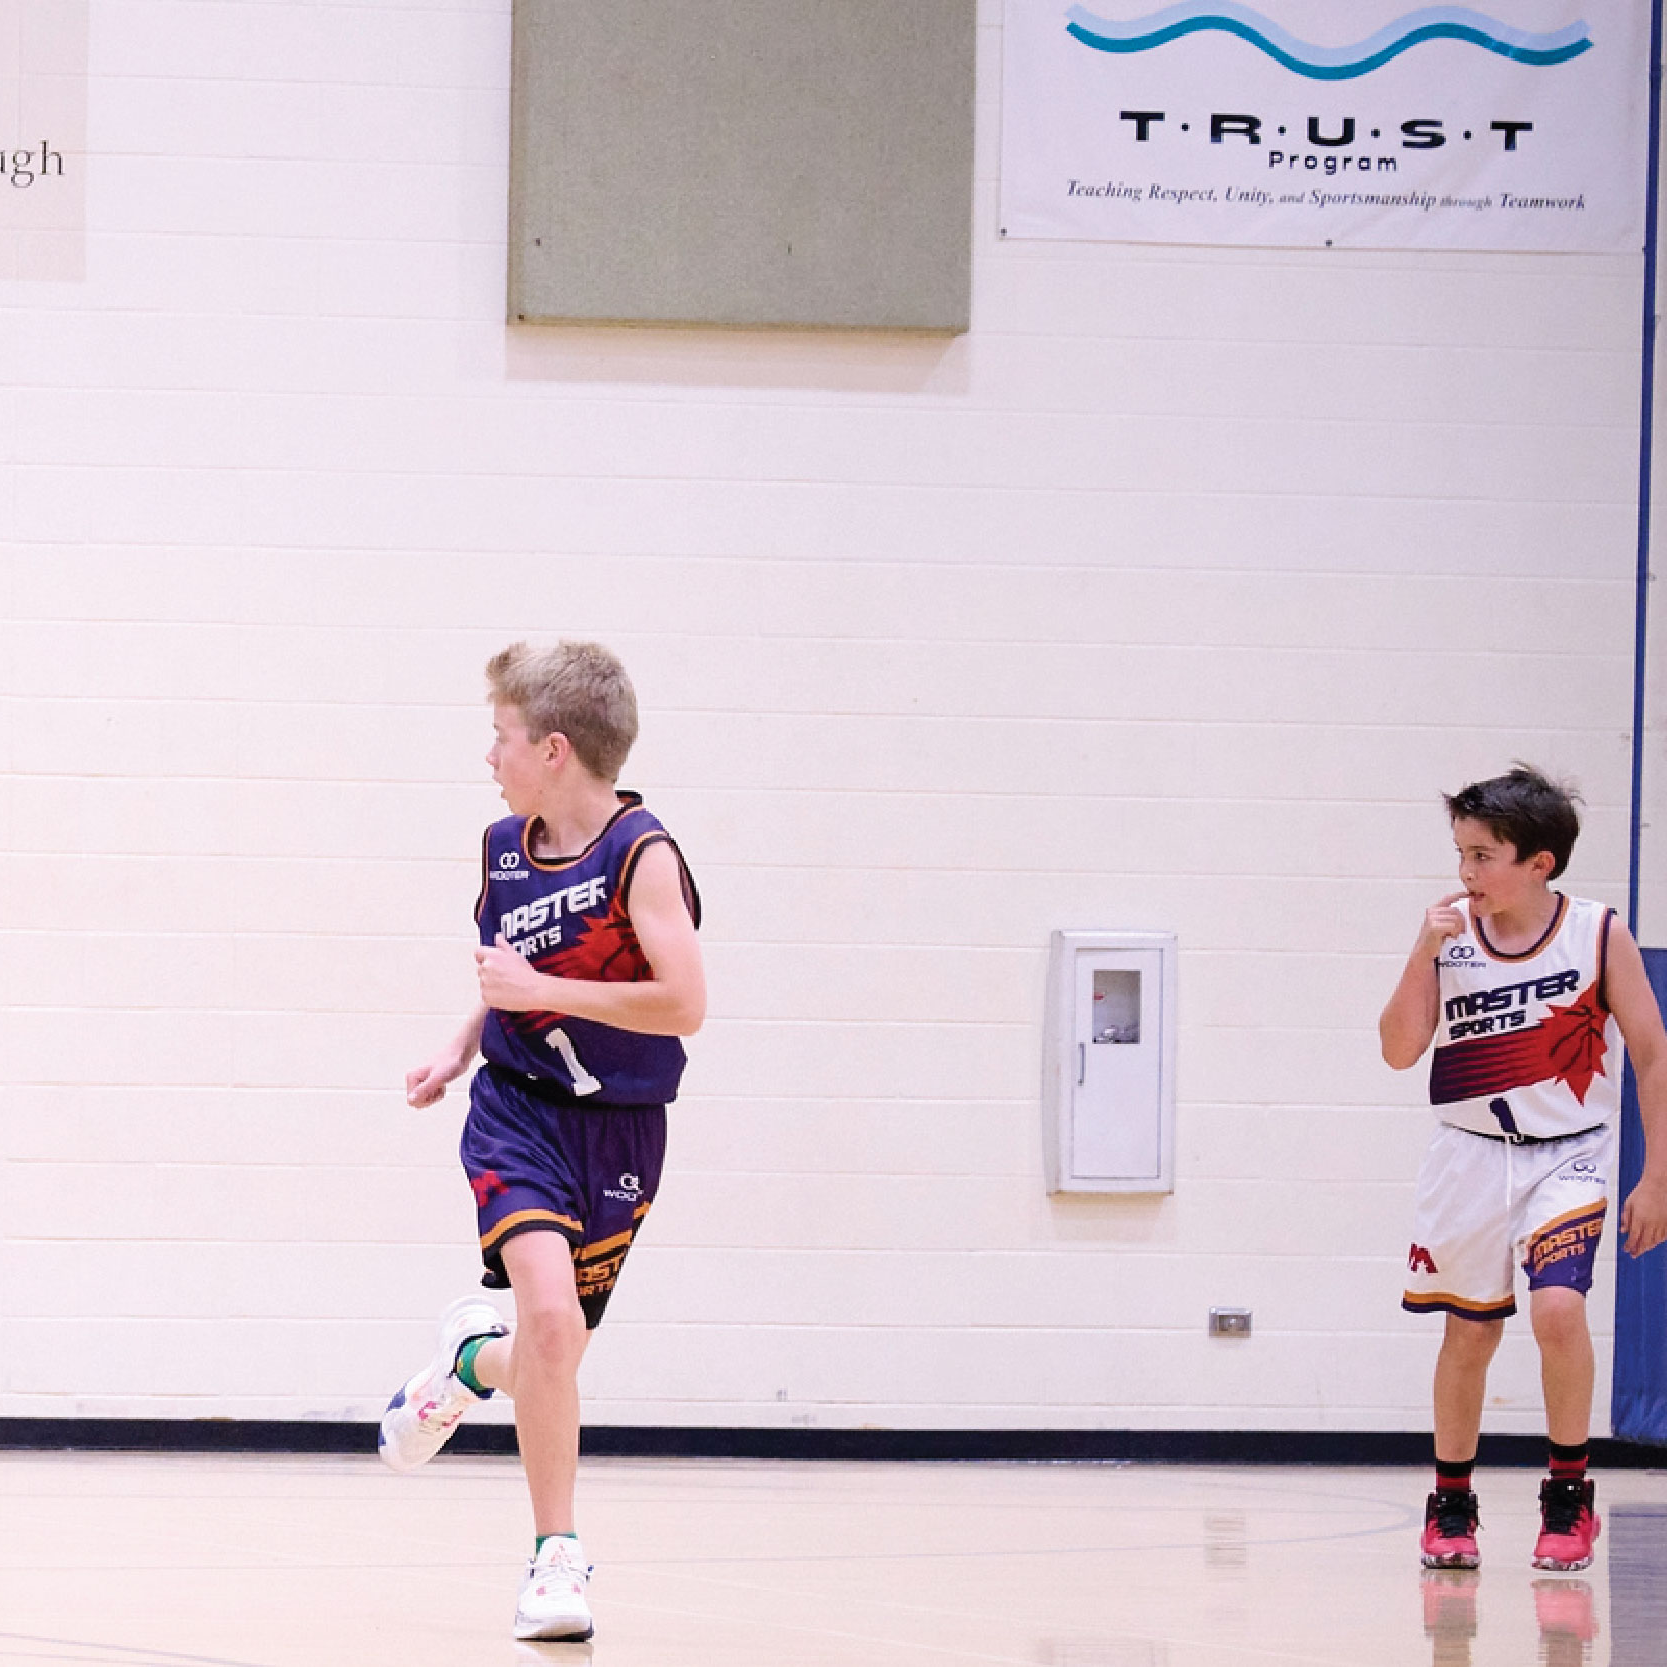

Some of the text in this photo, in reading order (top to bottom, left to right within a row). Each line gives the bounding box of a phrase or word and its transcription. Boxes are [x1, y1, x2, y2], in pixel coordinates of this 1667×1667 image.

[1268, 151, 1398, 176] Program
[1068, 179, 1143, 202] Teaching
[1149, 183, 1218, 204] Respect,
[1225, 186, 1275, 206] Unity,
[1279, 192, 1306, 204] and
[1308, 189, 1437, 211] Sportsmanship
[1500, 193, 1585, 211] Teamwork
[512, 923, 562, 956] ORTS
[1445, 968, 1581, 1022] MASTER
[1448, 1008, 1528, 1041] SPORTS
[544, 1027, 602, 1097] 1
[1533, 1218, 1604, 1260] MASTE
